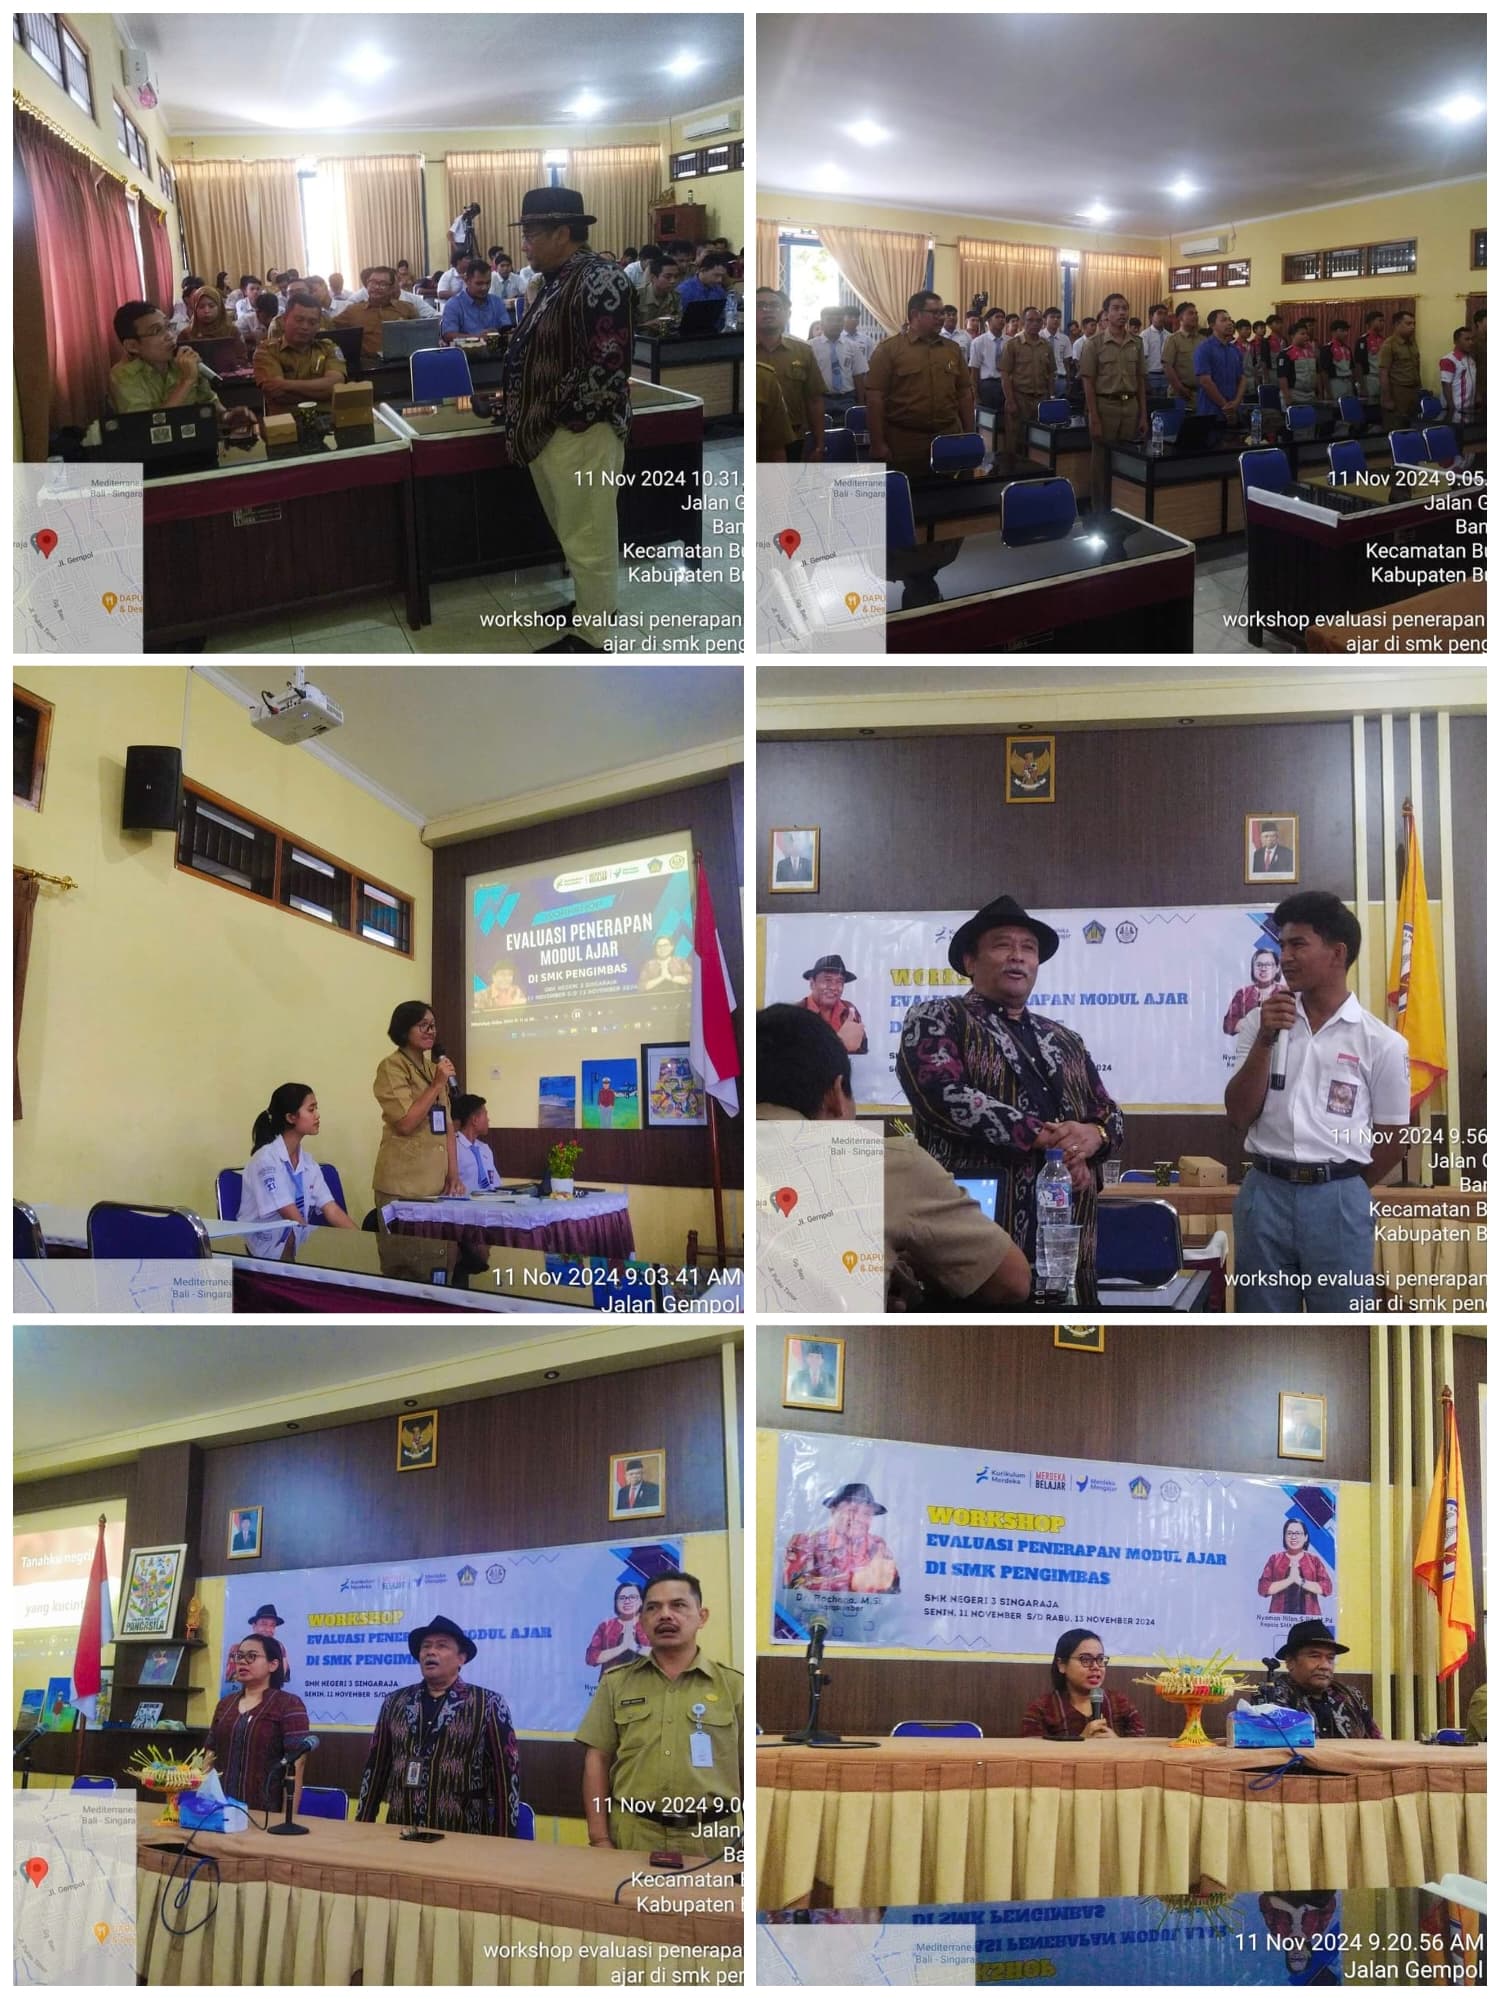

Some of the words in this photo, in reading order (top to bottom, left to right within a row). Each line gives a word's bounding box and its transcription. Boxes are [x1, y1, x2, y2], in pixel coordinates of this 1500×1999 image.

[506, 927, 567, 951] EVALUASI
[570, 912, 653, 943] PENERAPAN
[540, 946, 583, 967] MODUL
[585, 940, 619, 960] AJAR
[528, 973, 539, 985] DI
[540, 970, 563, 983] SMK
[565, 963, 628, 980] PENGIMBAS
[1079, 993, 1140, 1006] MODUL
[1143, 992, 1189, 1005] AJAR
[1035, 1471, 1066, 1481] MERDEKA
[1035, 1480, 1066, 1491] BELAJAR
[927, 1505, 1066, 1534] WORKSHOP
[926, 1533, 1014, 1552] EVALUASI
[1017, 1540, 1121, 1559] PENERAPAN
[1125, 1547, 1182, 1563] MODUL
[1186, 1551, 1227, 1566] AJAR
[925, 1561, 947, 1575] DI
[951, 1562, 996, 1578] SMK
[1000, 1565, 1111, 1585] PENGIMBAS
[924, 1593, 947, 1603] SMK
[949, 1595, 988, 1605] NEGERI
[991, 1597, 997, 1605] 3
[999, 1597, 1060, 1609] SINGARAJA
[24, 1603, 50, 1618] yang
[306, 1609, 404, 1628] WORKSHOP
[959, 1609, 968, 1617] 11
[970, 1610, 1022, 1620] NOVEMBER
[1026, 1612, 1044, 1621] S/D
[1086, 1615, 1133, 1625] NOVEMBER
[1135, 1617, 1156, 1626] 2024
[126, 1620, 165, 1632] PANCASILA
[306, 1633, 366, 1645] EVALUASI
[510, 1626, 552, 1639] AJAR
[305, 1655, 319, 1666] DI
[322, 1654, 353, 1666] SMK
[354, 1679, 399, 1687] SINGARAJA
